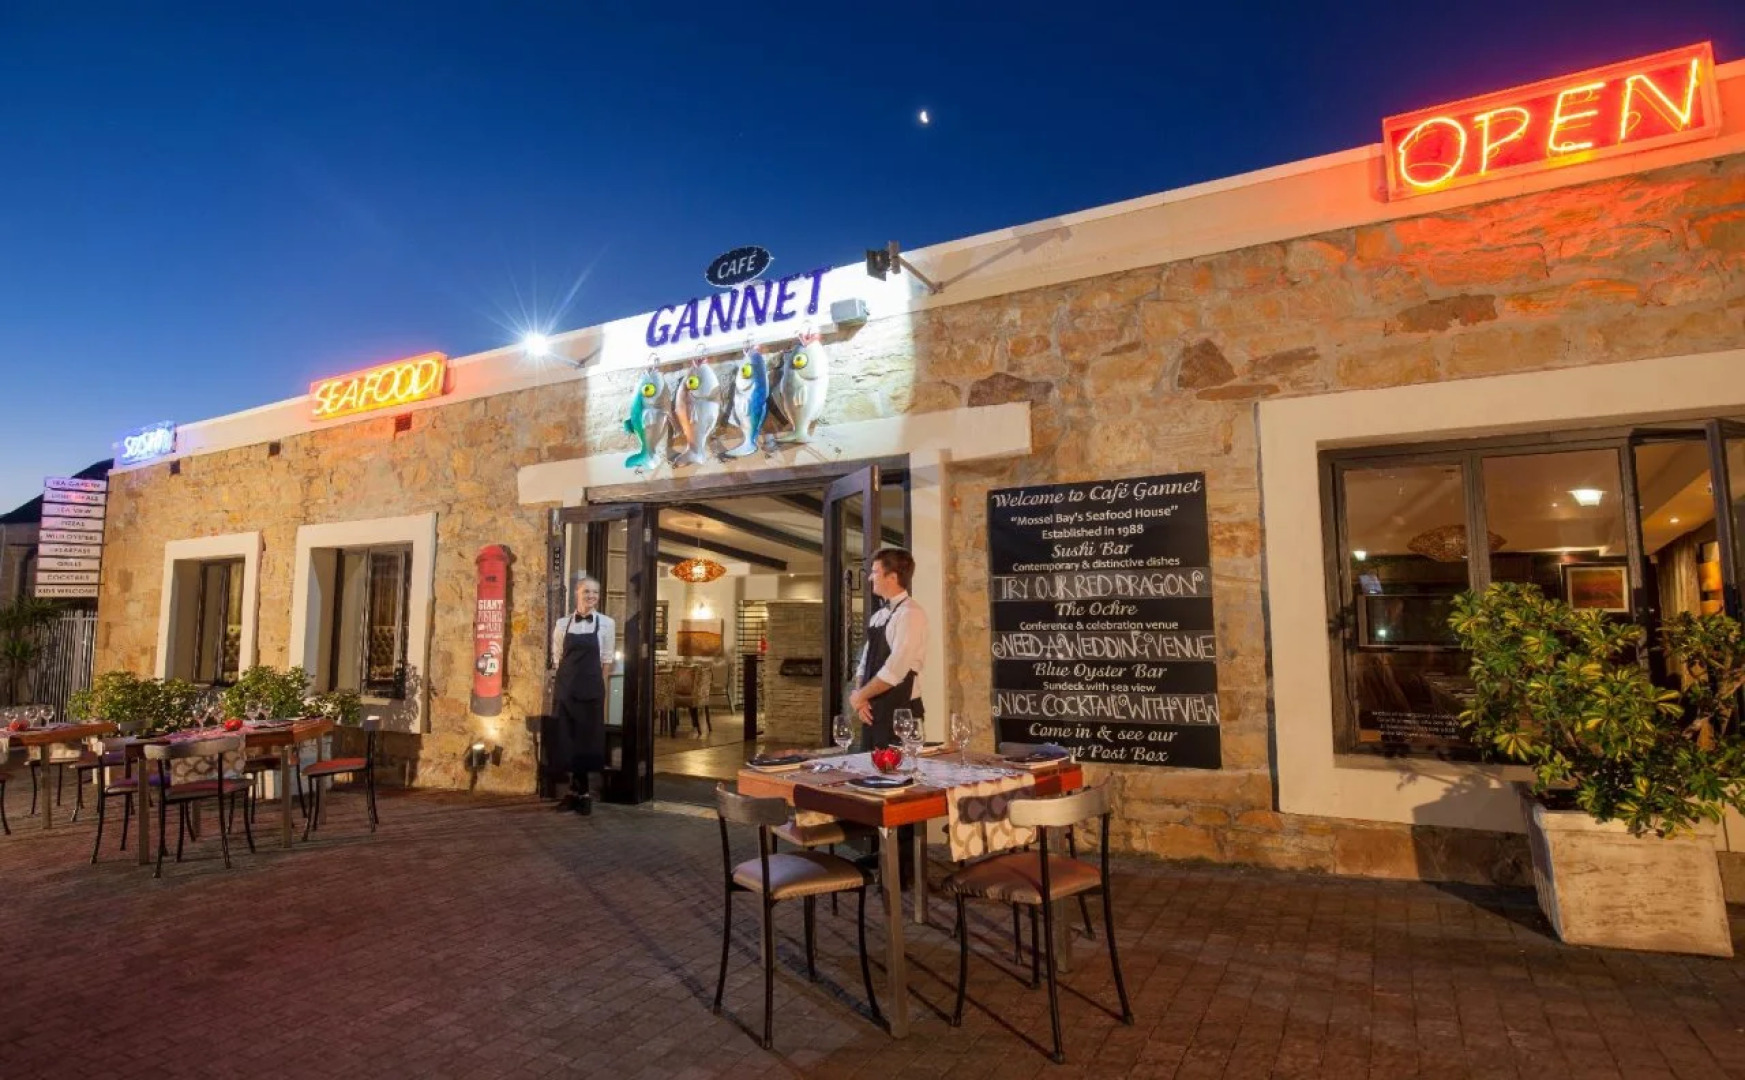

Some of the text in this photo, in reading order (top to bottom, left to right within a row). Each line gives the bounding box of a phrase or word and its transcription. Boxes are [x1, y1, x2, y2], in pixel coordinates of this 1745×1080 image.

[1398, 57, 1699, 187] OPEN
[717, 249, 757, 279] CAFÉ
[646, 266, 832, 347] GANNET
[312, 360, 437, 416] SEAFOOD
[992, 479, 1202, 508] Welcome to Café Gannet
[1086, 508, 1132, 521] Seafood
[1042, 524, 1145, 539] Established in 1988
[1051, 541, 1134, 558] Sushi Bar
[1012, 556, 1180, 573] Contemporary & distinctive dishes
[992, 570, 1204, 599] TRY OUR RED DRAGON
[478, 600, 503, 611] GIANT
[1055, 600, 1138, 616] The Ochre
[1020, 620, 1179, 631] Conference & celebration venue
[992, 633, 1043, 659] NEED
[1057, 630, 1150, 660] WEDDING
[1146, 633, 1217, 660] VENUE
[1033, 661, 1168, 681] Blue Oyster Bar
[1043, 681, 1156, 692] Sundeck with sea view
[992, 691, 1040, 717] NICE
[1029, 722, 1178, 742] Come in & see our
[1088, 744, 1128, 759] Post
[1131, 746, 1170, 762] Box
